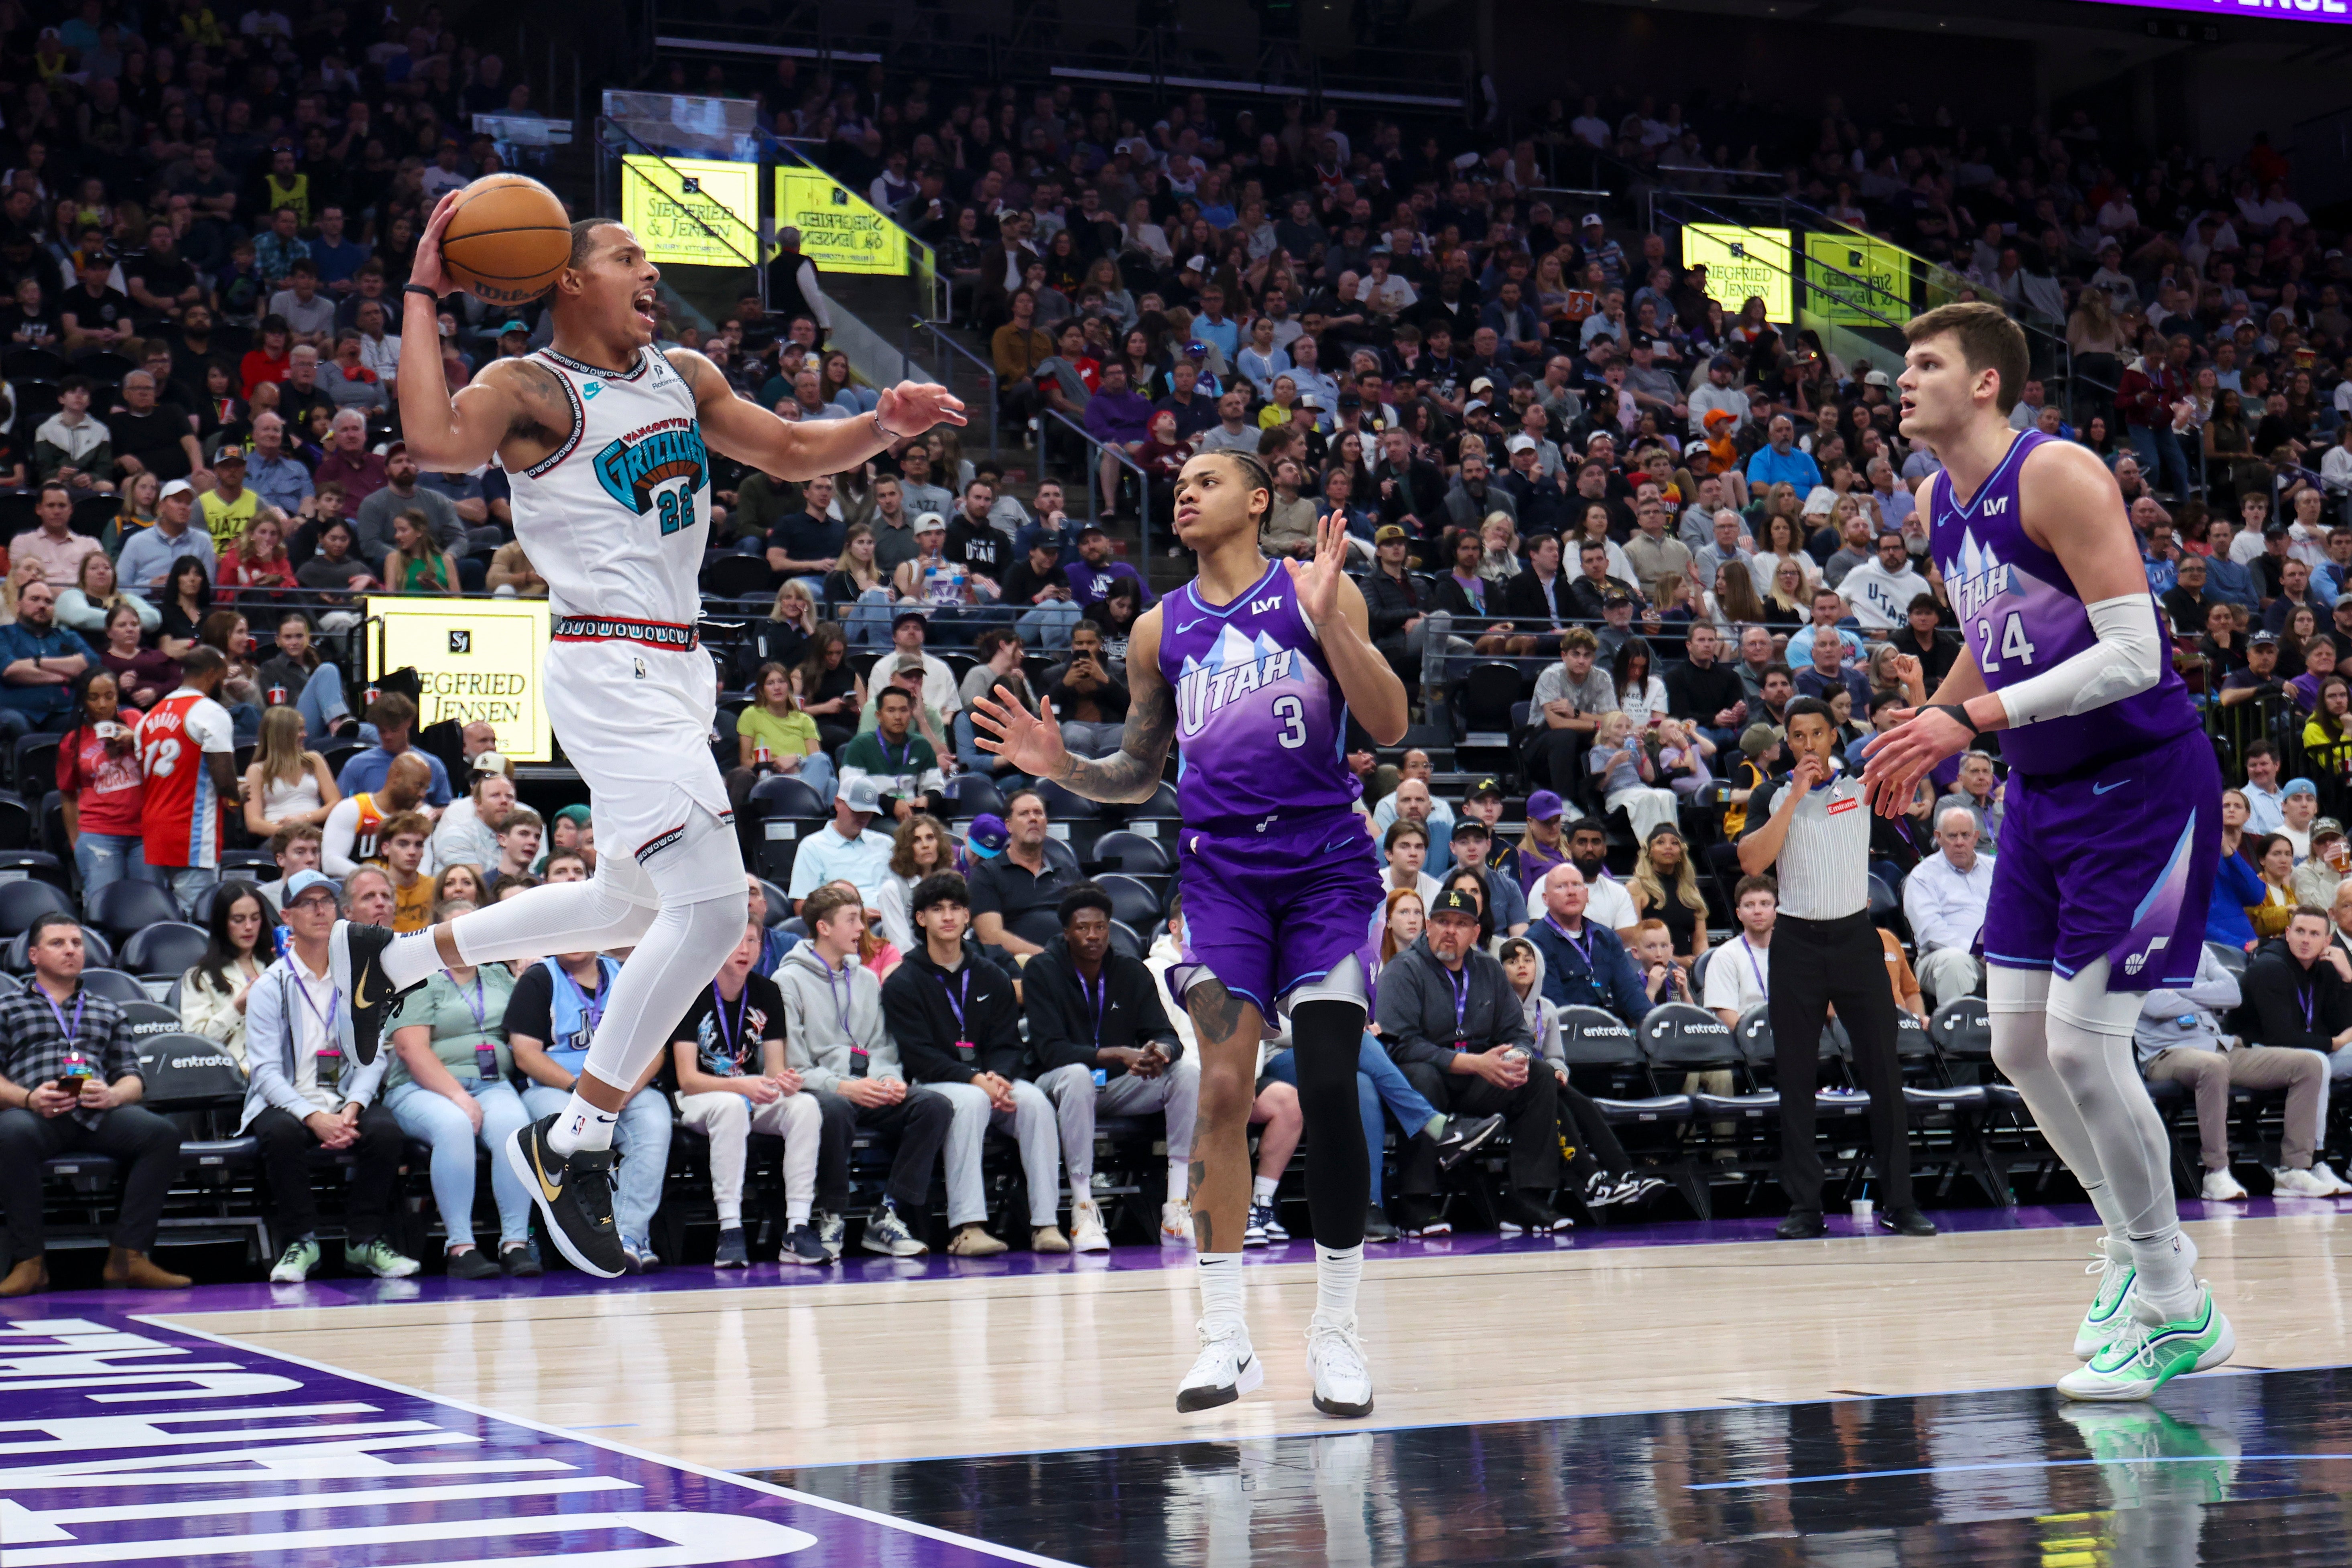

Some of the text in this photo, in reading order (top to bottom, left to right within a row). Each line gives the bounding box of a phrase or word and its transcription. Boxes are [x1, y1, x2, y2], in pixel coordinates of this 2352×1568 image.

[647, 219, 663, 237] &
[1704, 262, 1772, 282] SIEGFRIED
[1722, 281, 1770, 299] JENSEN
[623, 418, 689, 443] VANCOUVER
[593, 420, 709, 516] GRIZZLIES
[656, 483, 695, 537] 22
[1983, 496, 2008, 517] LVT
[1251, 595, 1283, 615] LVT
[1868, 583, 1909, 628] UTAH
[1945, 563, 2009, 636] UTAH
[1978, 611, 2035, 674] 24
[1178, 649, 1292, 736] UTAH
[432, 696, 521, 723] JENSEN
[1272, 695, 1308, 749] 3
[144, 738, 181, 778] 12
[1827, 800, 1858, 814] Emirates
[133, 1021, 185, 1034] entrat
[1583, 1026, 1630, 1037] entrata
[1684, 1024, 1730, 1035] entrata
[172, 1055, 234, 1069] entrata
